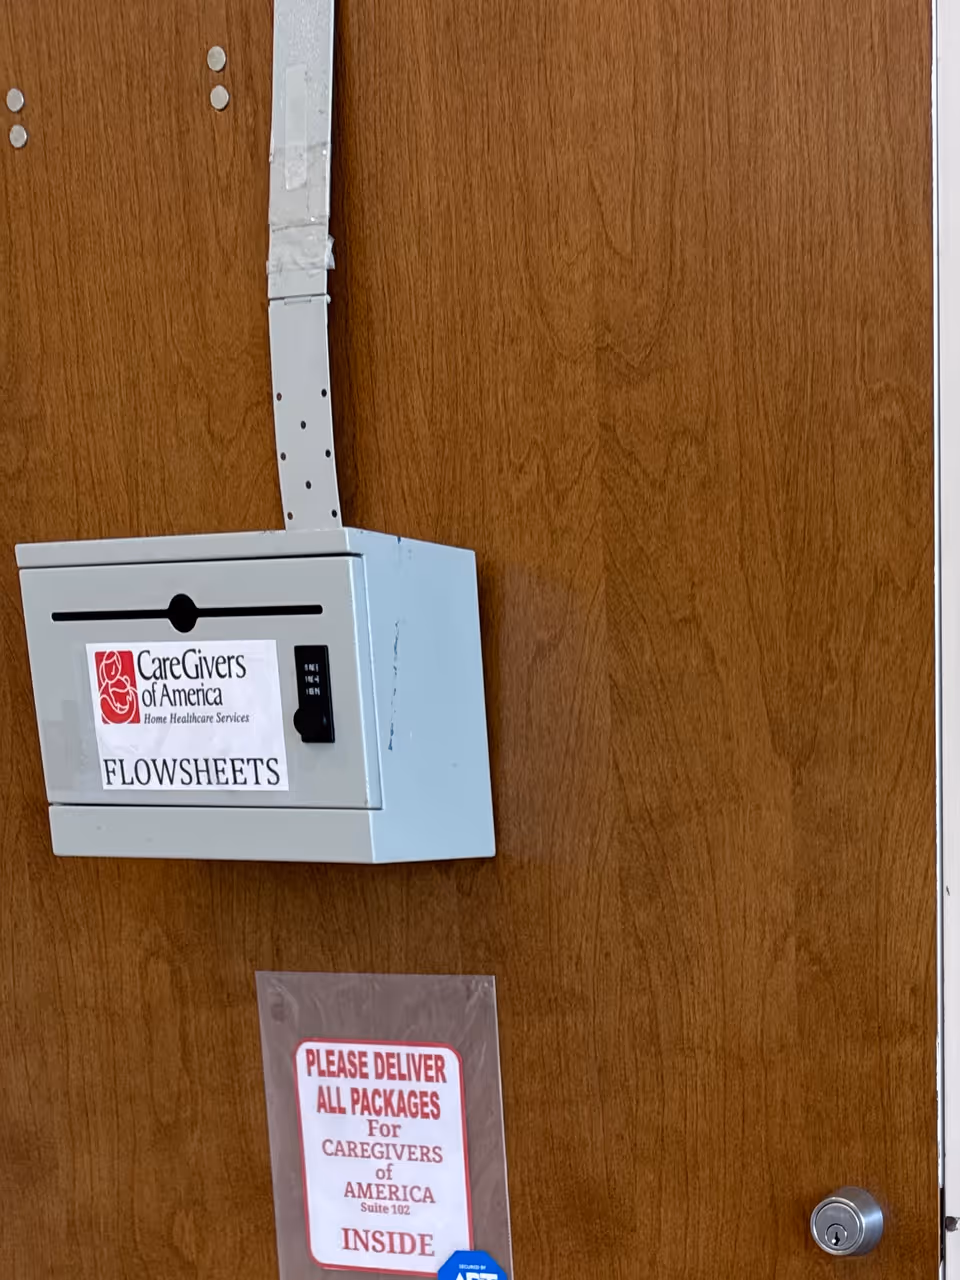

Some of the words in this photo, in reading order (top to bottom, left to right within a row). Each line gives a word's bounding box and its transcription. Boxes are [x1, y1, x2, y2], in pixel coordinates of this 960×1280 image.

[138, 649, 246, 680] CareGivers
[142, 682, 157, 707] of
[160, 683, 223, 707] America
[144, 713, 167, 724] Home
[170, 713, 213, 724] Healthcare
[216, 712, 249, 723] Services
[103, 758, 280, 785] FLOWSHEETS
[306, 1049, 369, 1079] PLEASE
[374, 1051, 447, 1083] DELIVER
[317, 1085, 346, 1114] ALL
[350, 1087, 441, 1120] PACKAGES
[367, 1119, 401, 1137] For
[322, 1139, 443, 1163] CAREGIVERS
[375, 1163, 394, 1180] of
[344, 1182, 436, 1203] AMERICA
[361, 1202, 389, 1214] Suite
[392, 1204, 410, 1215] 102
[341, 1228, 435, 1256] INSIDE
